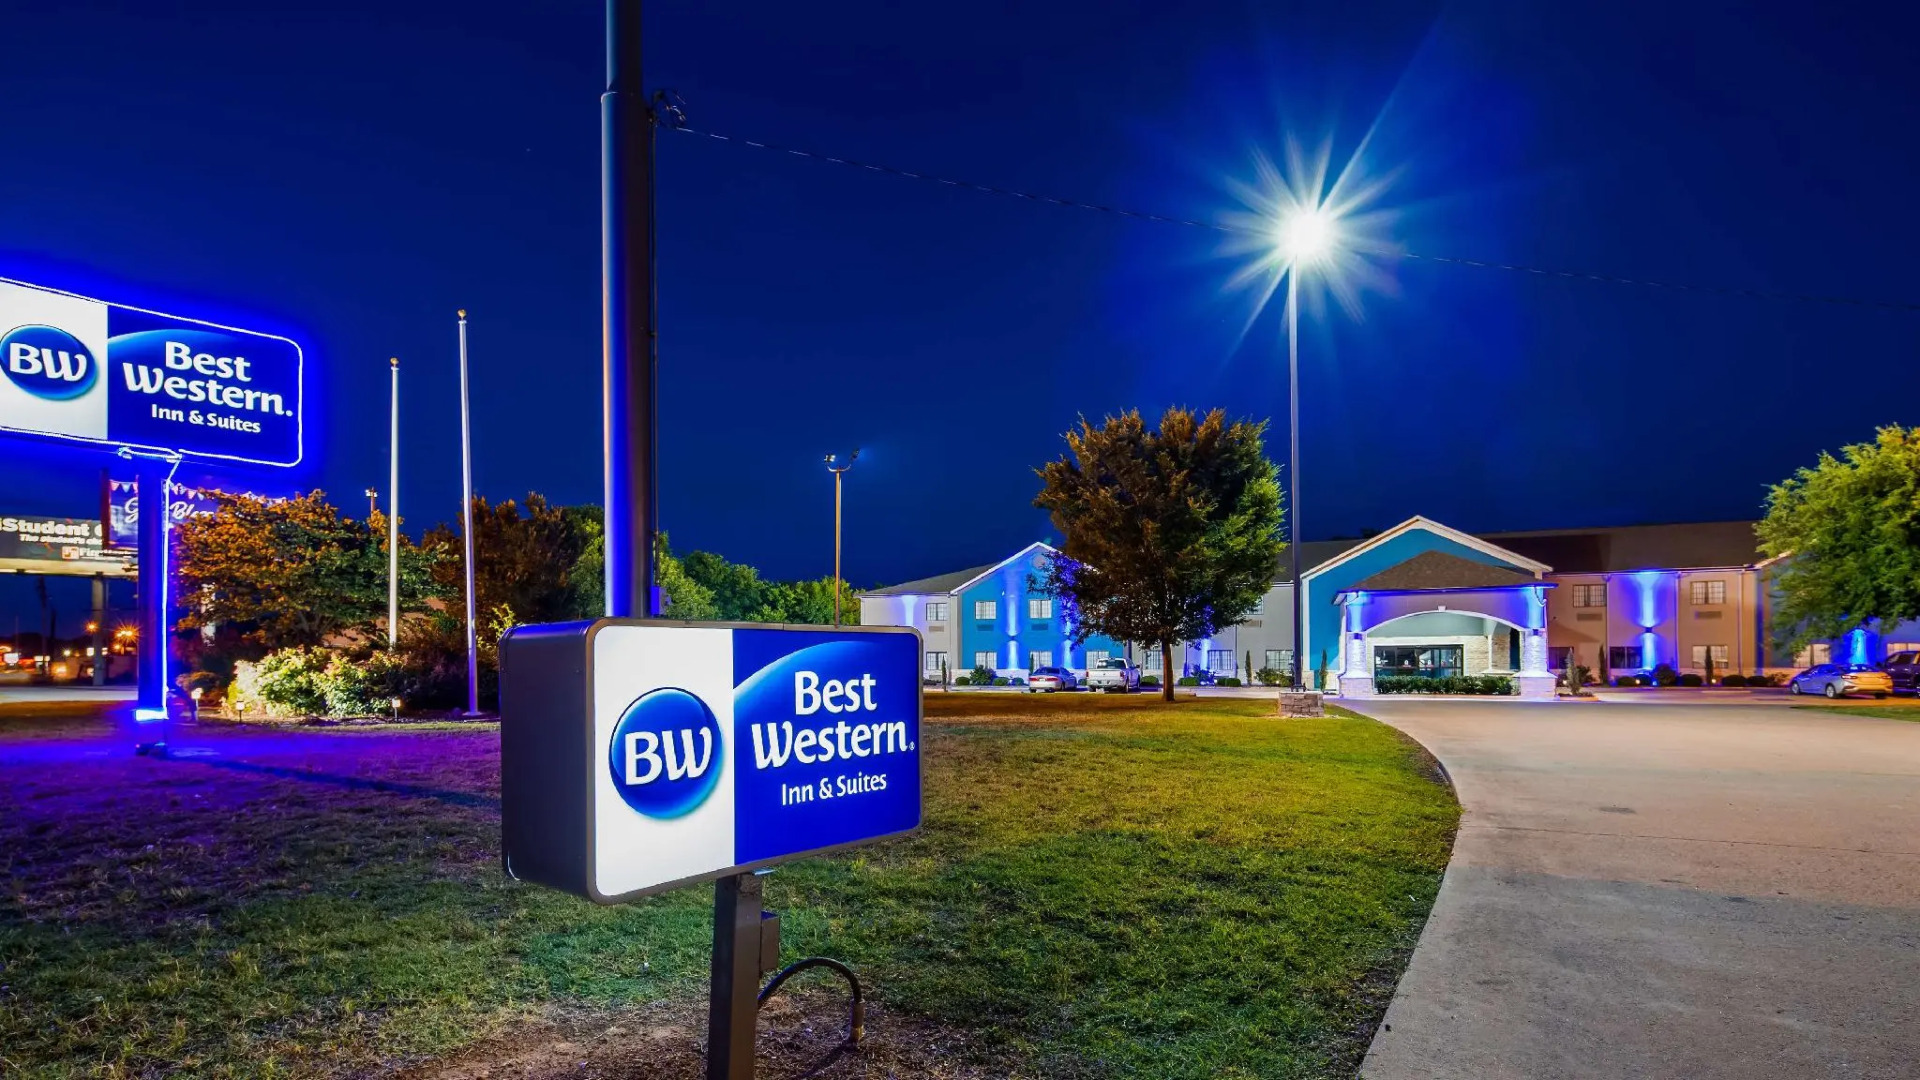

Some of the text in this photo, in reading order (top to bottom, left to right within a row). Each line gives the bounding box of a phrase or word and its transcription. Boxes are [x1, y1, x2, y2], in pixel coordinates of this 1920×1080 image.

[9, 342, 87, 382] BW
[165, 340, 252, 382] Best
[151, 403, 262, 434] Inn & Suites
[794, 670, 878, 716] Best
[624, 725, 713, 786] BW
[781, 771, 888, 806] Inn & Suites
